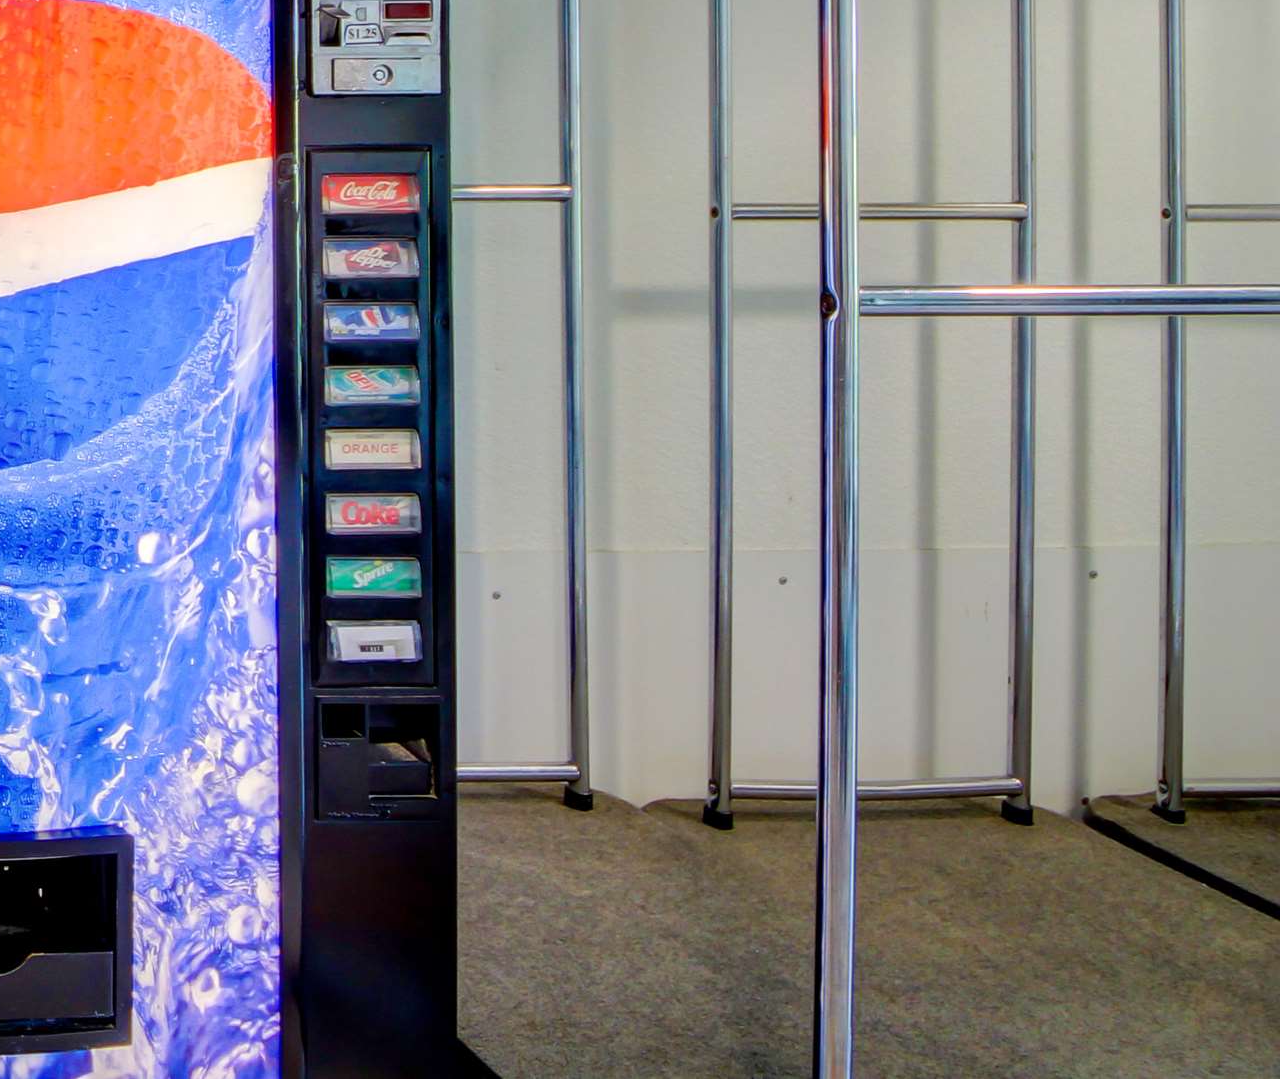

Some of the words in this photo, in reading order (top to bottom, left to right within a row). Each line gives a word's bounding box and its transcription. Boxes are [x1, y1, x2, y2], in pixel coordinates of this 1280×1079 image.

[348, 28, 378, 39] $1.25
[342, 443, 399, 454] ORANGE
[341, 500, 400, 526] Coke
[353, 561, 394, 589] Sprite
